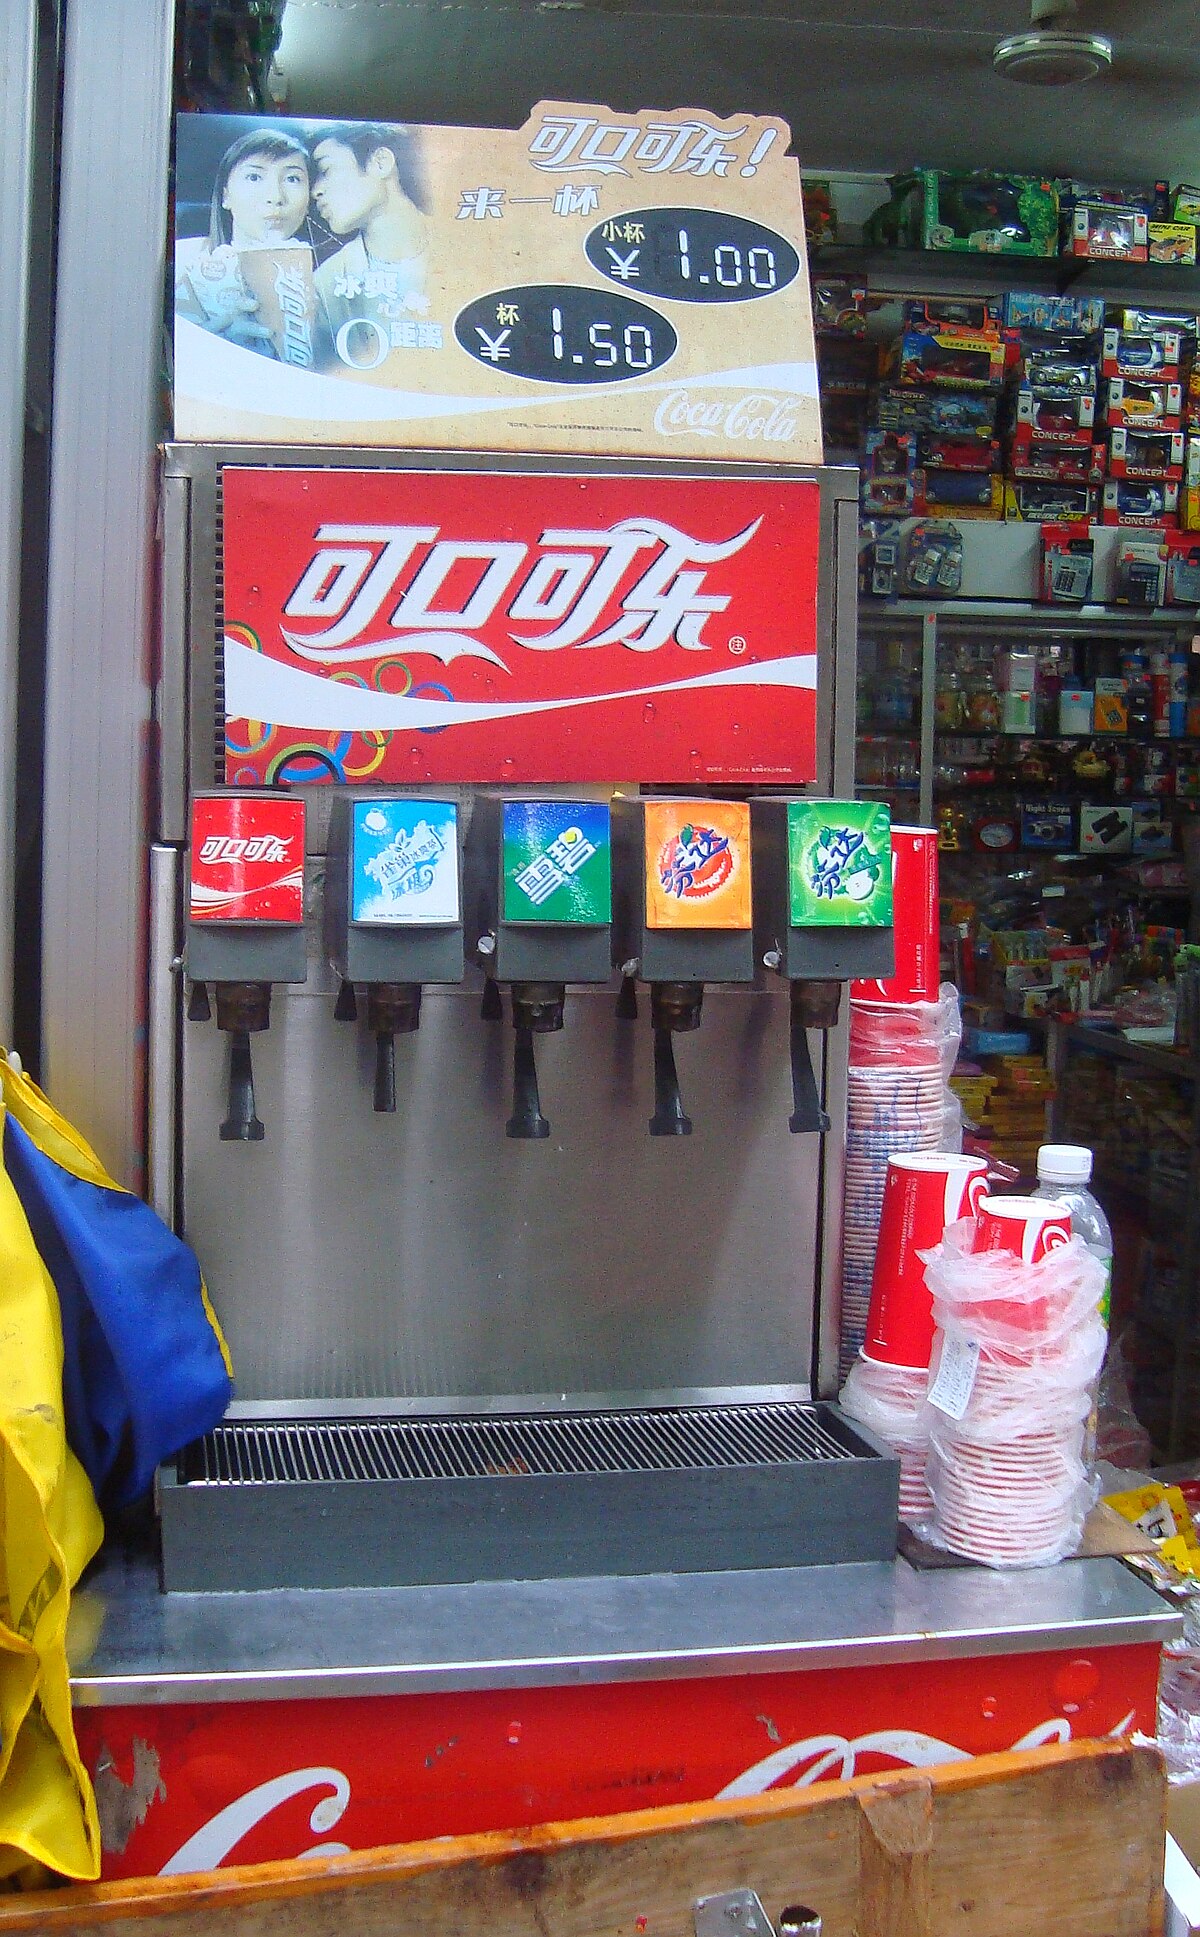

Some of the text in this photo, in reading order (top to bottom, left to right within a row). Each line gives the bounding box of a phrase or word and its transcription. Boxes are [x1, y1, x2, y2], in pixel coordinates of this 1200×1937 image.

[455, 184, 602, 219] 来一杯
[601, 220, 646, 244] 小杯
[605, 229, 776, 289] ¥ 1.00
[1088, 247, 1132, 258] CONCEPT
[496, 302, 521, 327] 杯
[474, 307, 653, 368] ¥ 1.50
[1118, 367, 1161, 378] CONCEPT
[1031, 431, 1076, 441] CONCEPT
[1122, 417, 1163, 428] CONCEPT
[1125, 466, 1167, 477] CONCEPT
[1118, 516, 1161, 525] CONCEPT
[279, 512, 764, 674] 可口可乐
[199, 834, 295, 864] 可口可乐
[515, 827, 597, 905] 雪碧
[661, 828, 728, 899] 芬达
[811, 827, 864, 899] 芬达
